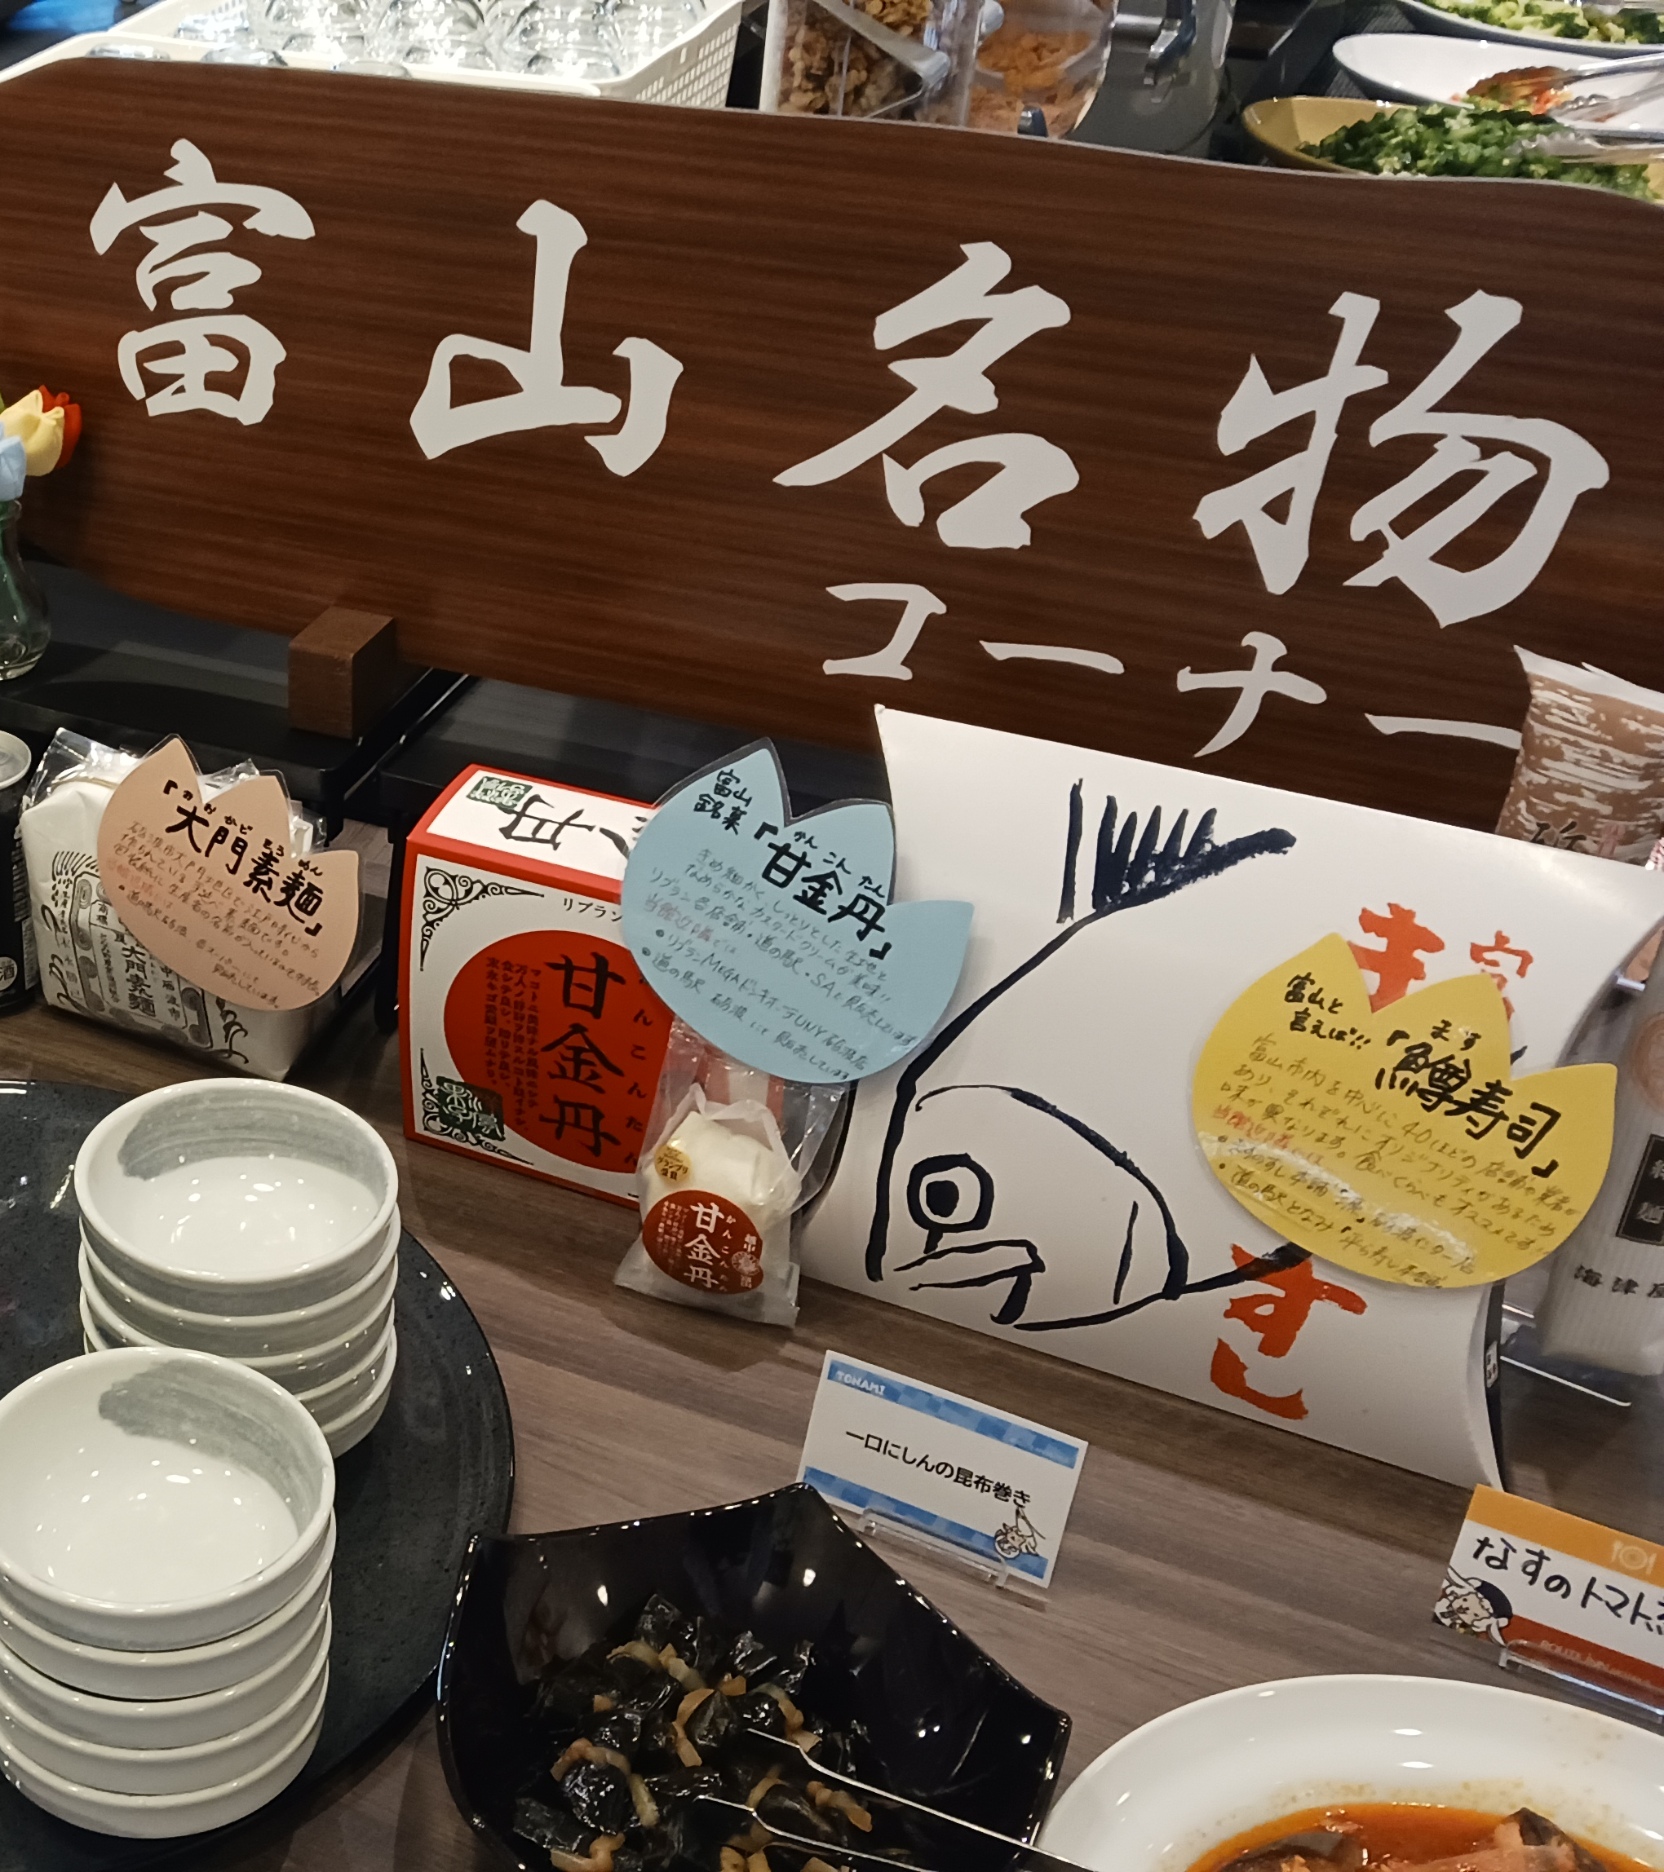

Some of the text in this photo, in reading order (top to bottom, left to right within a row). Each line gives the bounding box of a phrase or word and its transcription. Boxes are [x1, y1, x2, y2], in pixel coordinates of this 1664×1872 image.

[89, 137, 1610, 628] 富山名物
[823, 582, 1523, 758] コーナー
[693, 792, 749, 836] 銘菓
[715, 768, 754, 808] 富山
[1283, 971, 1345, 1015] 富山と
[539, 952, 626, 1158] 甘金丹
[683, 1201, 725, 1289] 甘金丹
[835, 1369, 887, 1397] TONAMI
[845, 1429, 1031, 1509] 一口にしんの昆布巻き
